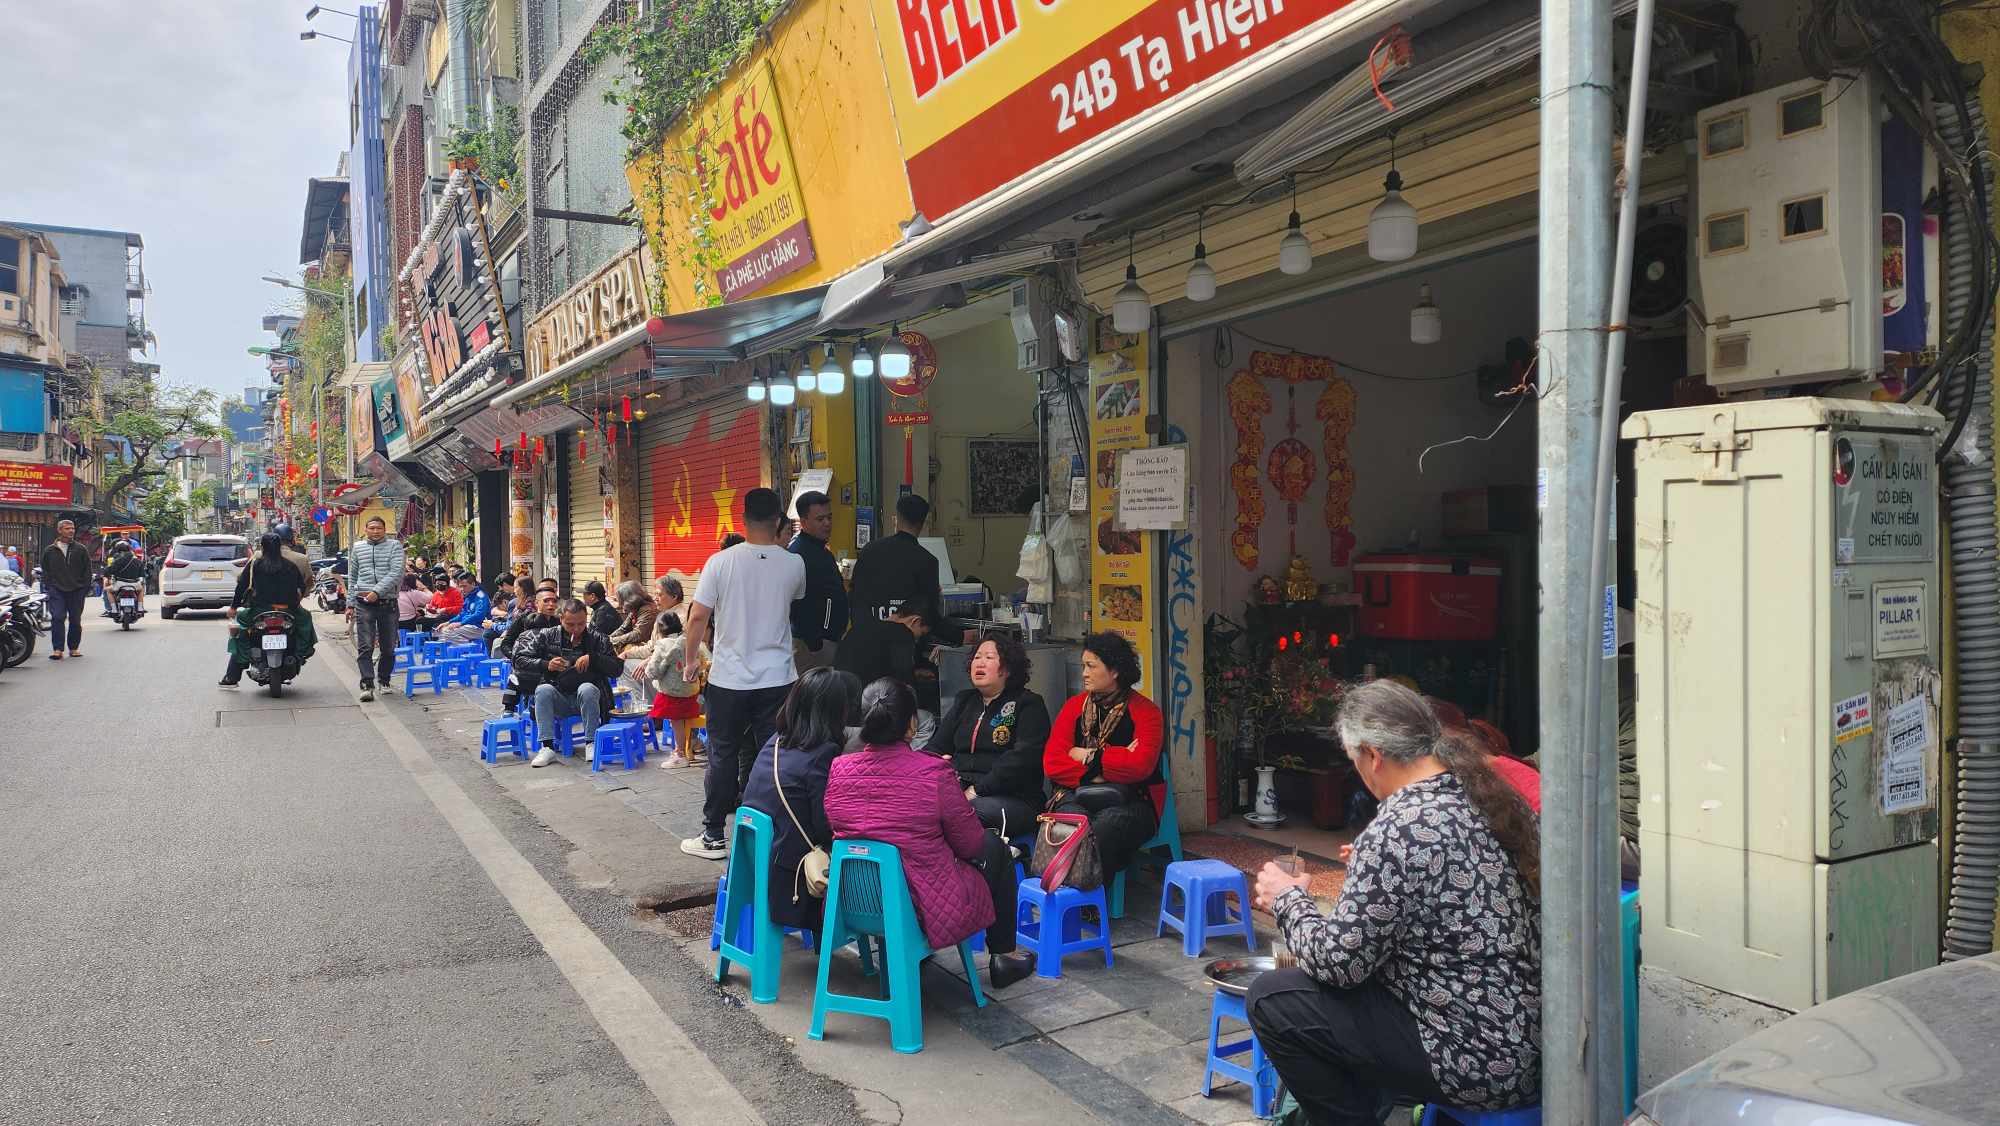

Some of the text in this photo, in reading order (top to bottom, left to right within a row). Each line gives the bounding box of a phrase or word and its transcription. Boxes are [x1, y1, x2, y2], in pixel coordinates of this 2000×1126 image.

[1050, 58, 1118, 134] 24B
[1119, 34, 1173, 93] Tạ
[725, 270, 739, 293] CÀ
[736, 259, 756, 286] PHÊ
[551, 283, 598, 361] DAISY
[599, 257, 641, 330] SPA
[1876, 487, 1913, 505] CÓ ĐIỆN
[1871, 505, 1920, 526] NGUY HIỂM
[1868, 529, 1892, 547] CHẾT
[1880, 607, 1921, 625] PILLAR 1
